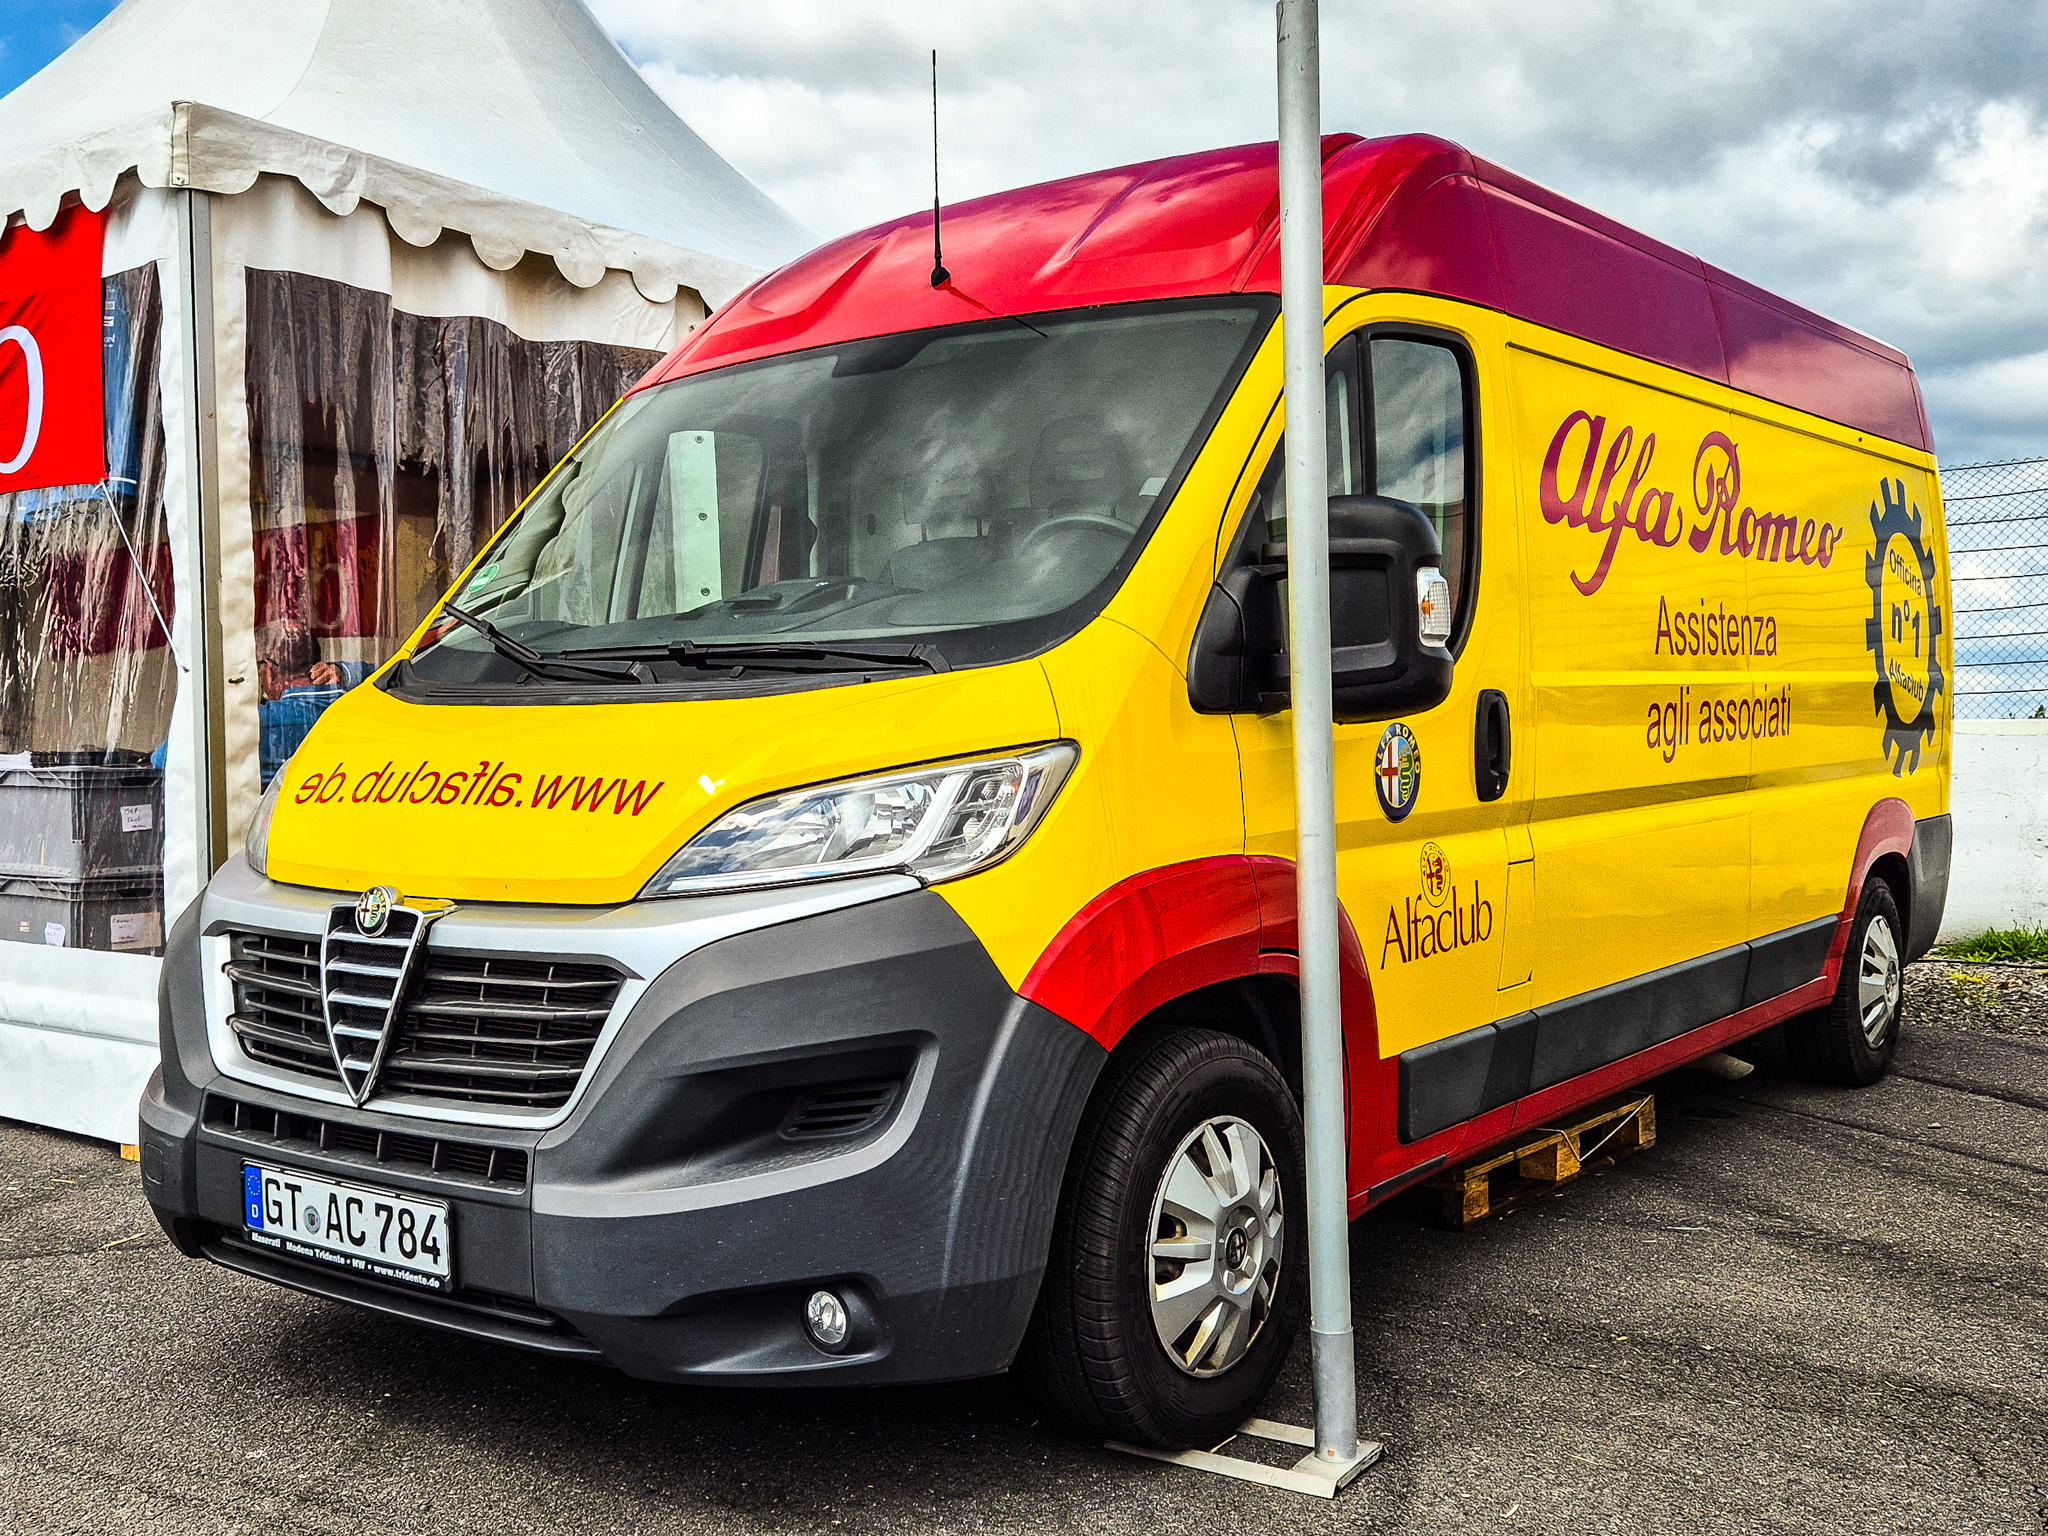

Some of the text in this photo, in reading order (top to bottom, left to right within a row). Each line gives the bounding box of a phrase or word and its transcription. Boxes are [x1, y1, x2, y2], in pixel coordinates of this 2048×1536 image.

[1540, 410, 1843, 596] Alfa Romeo
[1889, 548, 1922, 597] Officina
[1654, 595, 1777, 657] Assistenza
[1889, 657, 1924, 703] Alfaclub
[1375, 723, 1421, 776] ALFA ROMEO
[1646, 682, 1791, 764] agli associati
[1380, 879, 1493, 970] Alfaclub
[251, 1203, 259, 1219] D
[264, 1177, 442, 1266] GT AC 784
[251, 1232, 281, 1249] Maserati
[285, 1240, 314, 1257] Modena
